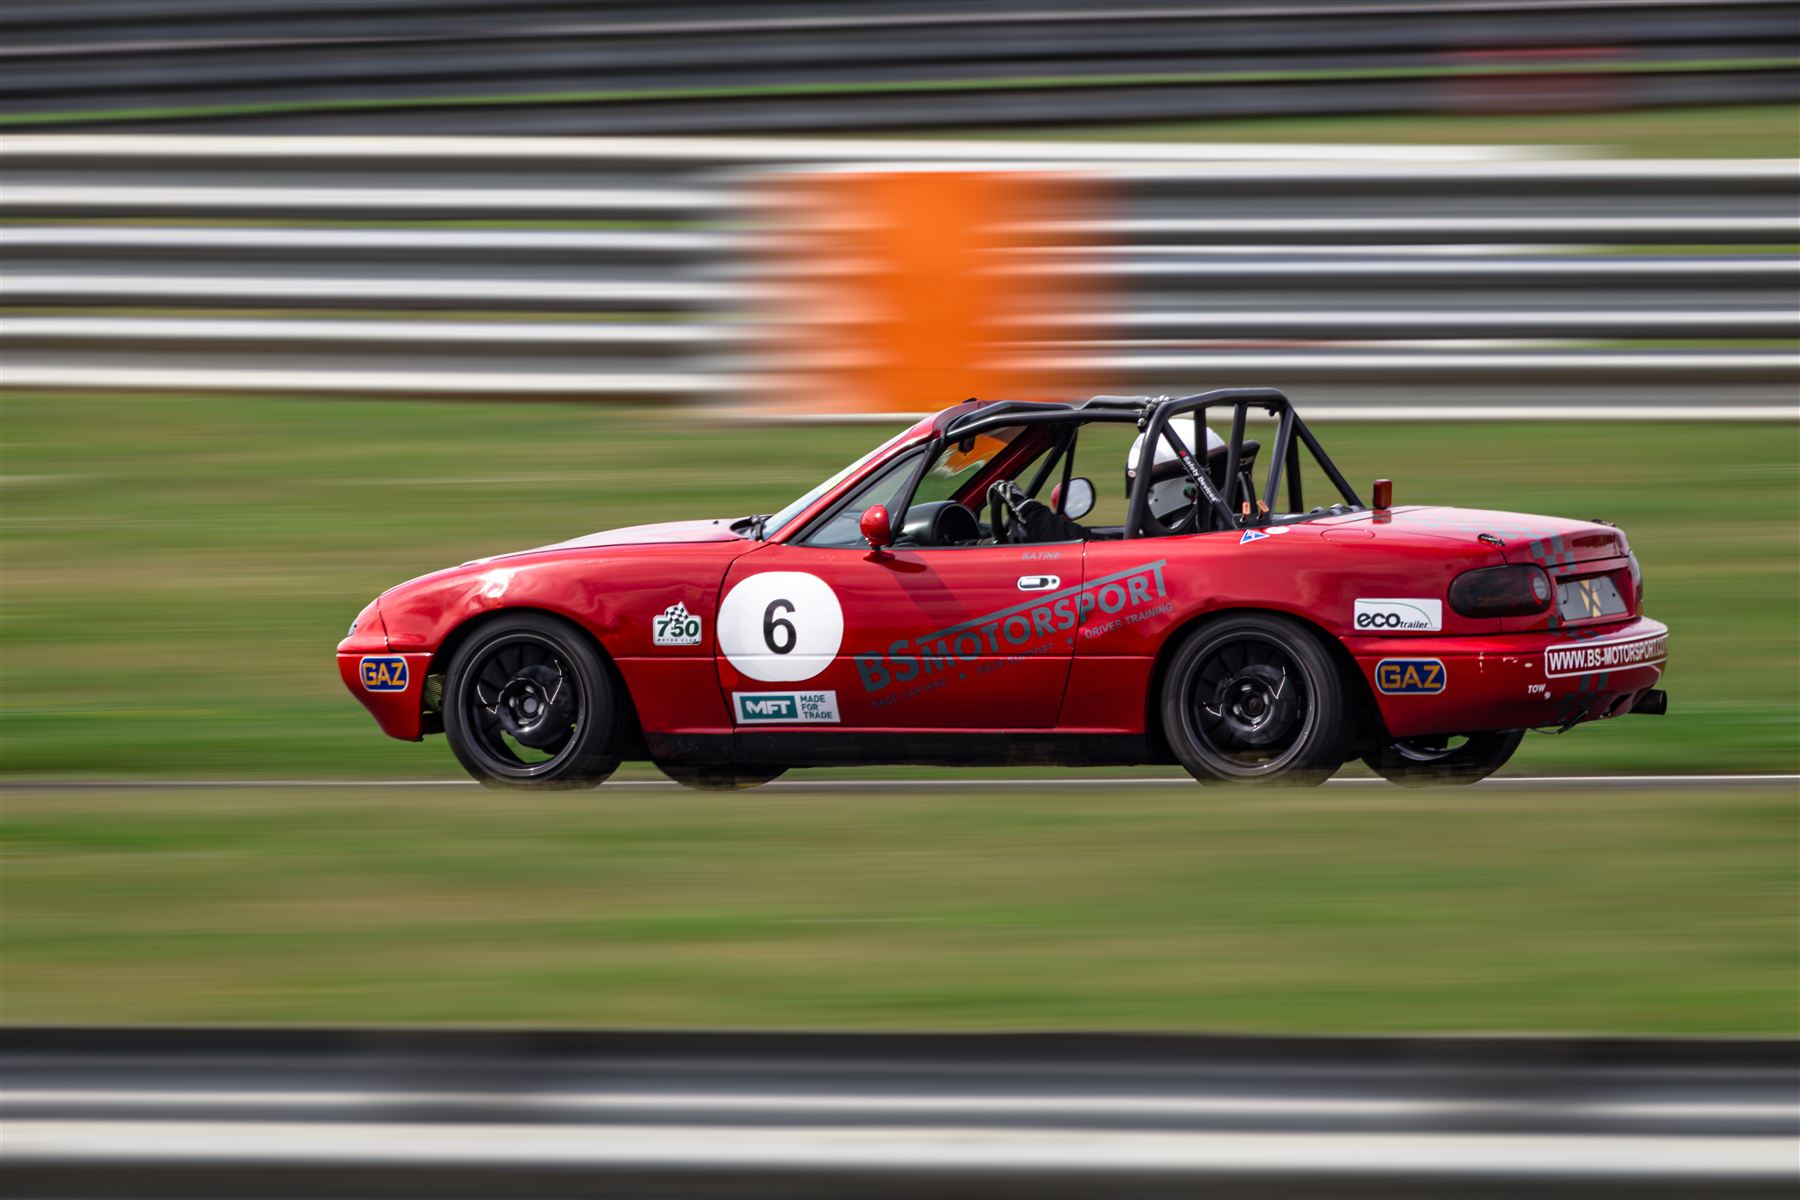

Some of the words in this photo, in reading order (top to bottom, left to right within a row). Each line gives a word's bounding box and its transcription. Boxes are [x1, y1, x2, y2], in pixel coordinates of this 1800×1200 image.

[1183, 455, 1200, 477] Safety
[657, 620, 700, 638] 750
[763, 599, 798, 655] 6
[1084, 619, 1122, 640] DRIVER
[1125, 602, 1174, 625] TRAINING
[1357, 613, 1401, 628] eco
[1400, 620, 1429, 629] trailer
[363, 662, 406, 686] GAZ
[1380, 665, 1442, 689] GAZ
[1528, 683, 1546, 694] TOW
[800, 694, 826, 703] MADE
[801, 703, 819, 711] FOR
[745, 700, 791, 715] MFT
[803, 711, 833, 720] TRADE
